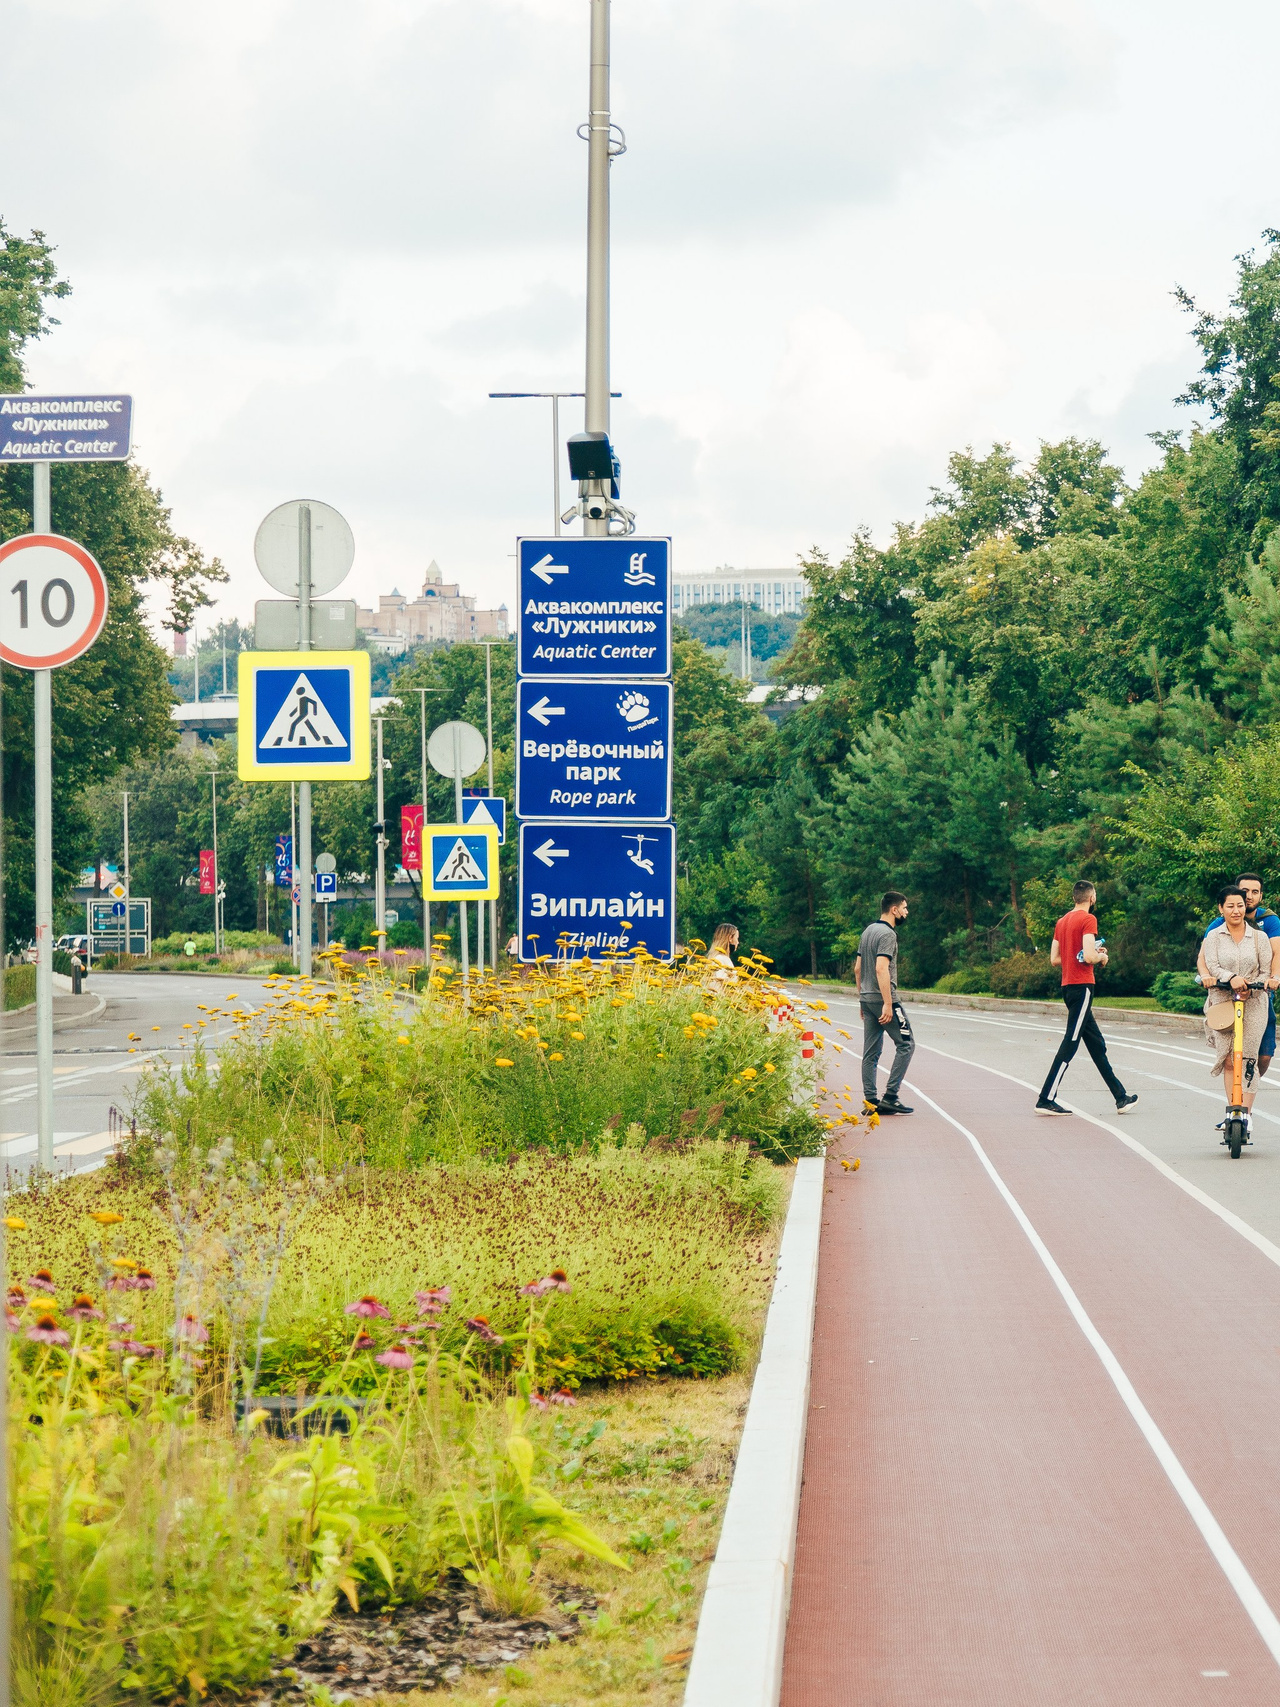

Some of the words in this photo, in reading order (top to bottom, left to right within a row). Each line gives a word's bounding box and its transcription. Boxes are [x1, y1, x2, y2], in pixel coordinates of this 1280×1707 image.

[0, 400, 123, 414] Аквакомплекс
[12, 417, 109, 435] «Лужники»
[2, 440, 62, 458] Aquatic
[64, 440, 118, 454] Center
[11, 578, 76, 629] 10
[525, 599, 664, 615] Аквакомплекс
[531, 617, 657, 638] «Лужники»
[532, 644, 597, 662] Aquatic
[601, 644, 657, 659] Center
[523, 739, 664, 763] Верёвочный
[566, 766, 622, 785] парк
[550, 789, 593, 808] Rope
[595, 789, 637, 808] park
[321, 875, 333, 892] P
[530, 891, 665, 917] Зиплайн
[569, 932, 630, 951] Zipline
